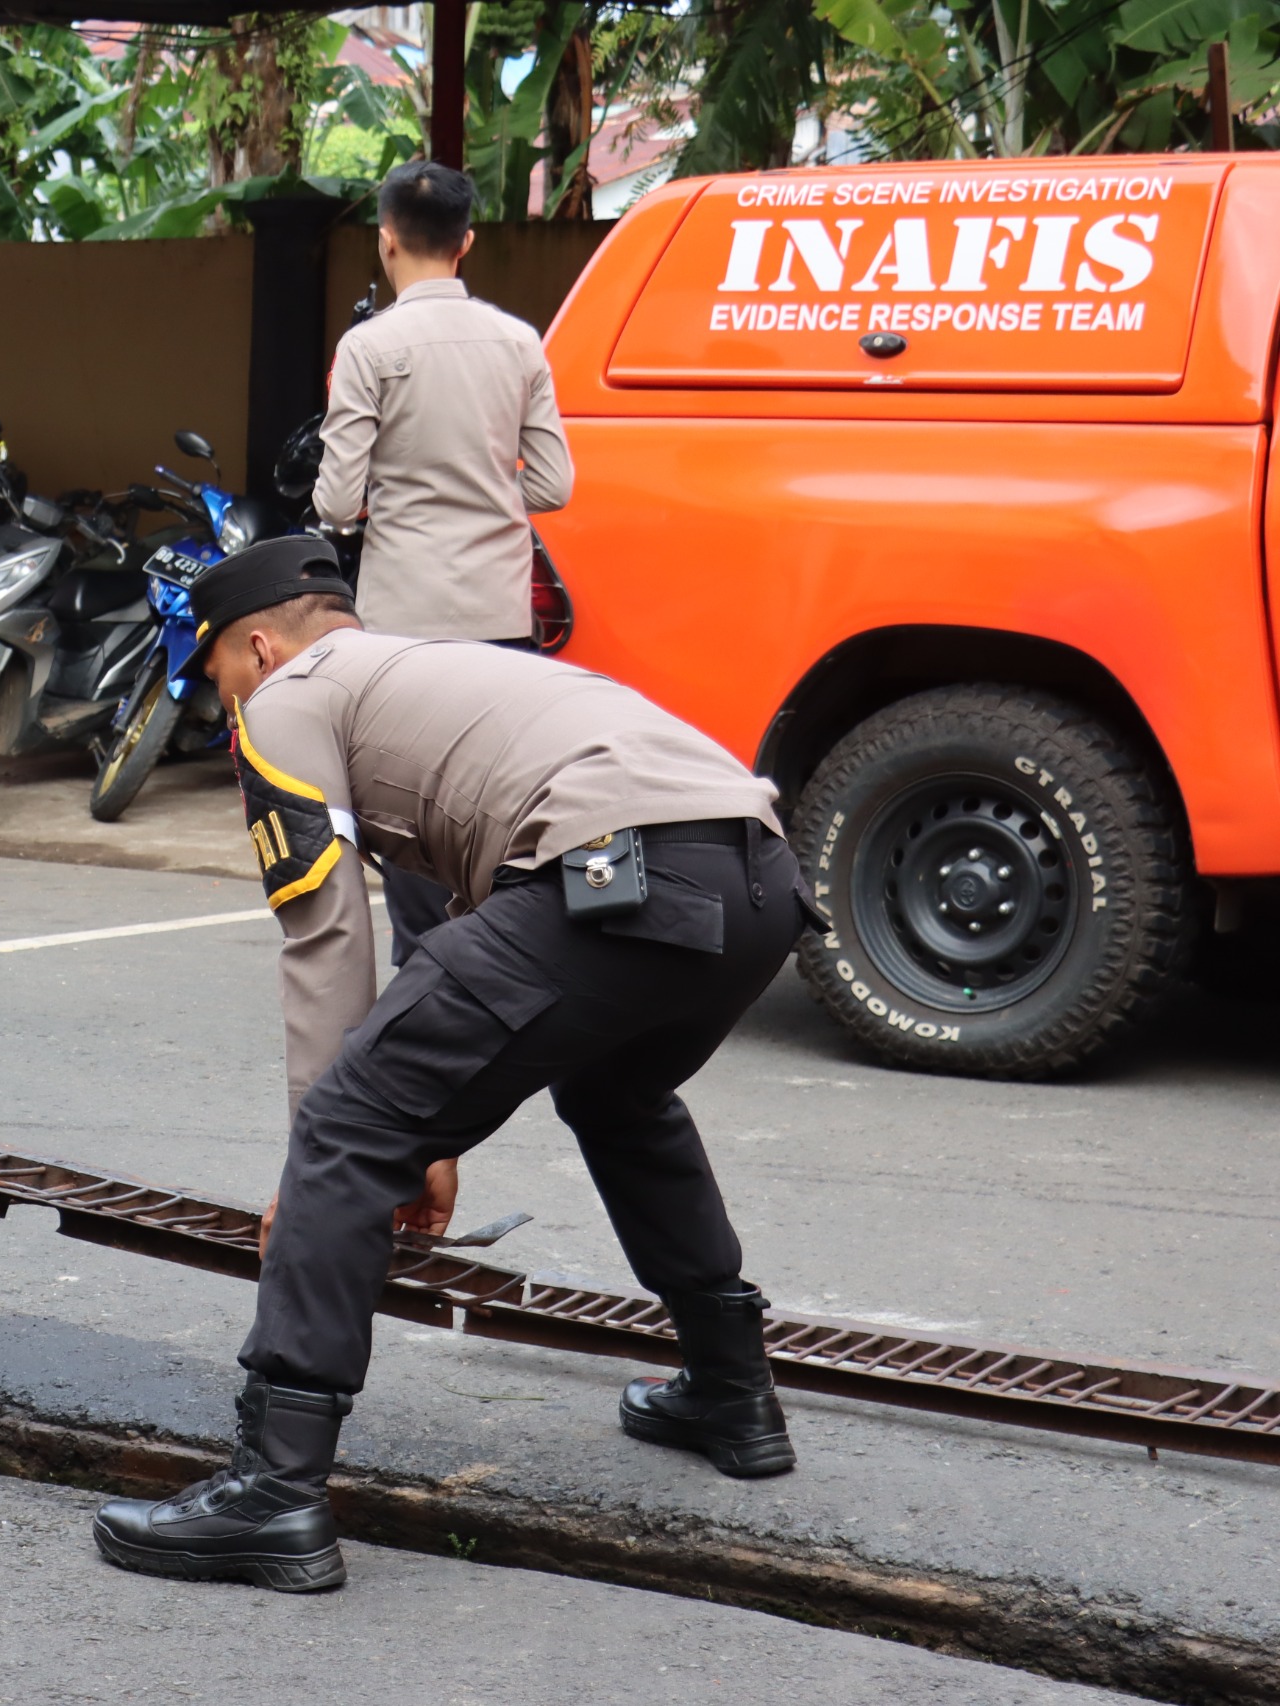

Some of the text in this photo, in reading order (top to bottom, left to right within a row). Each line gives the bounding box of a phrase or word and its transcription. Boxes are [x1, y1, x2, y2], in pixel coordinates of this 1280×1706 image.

[737, 176, 1173, 207] CRIME SCENE INVESTIGATION
[717, 213, 1159, 293] INAFIS
[709, 303, 1145, 331] EVIDENCE RESPONSE TEAM
[819, 811, 845, 871] PLUS
[1014, 756, 1106, 912] GT RADIAL
[836, 959, 960, 1041] KOMODO
